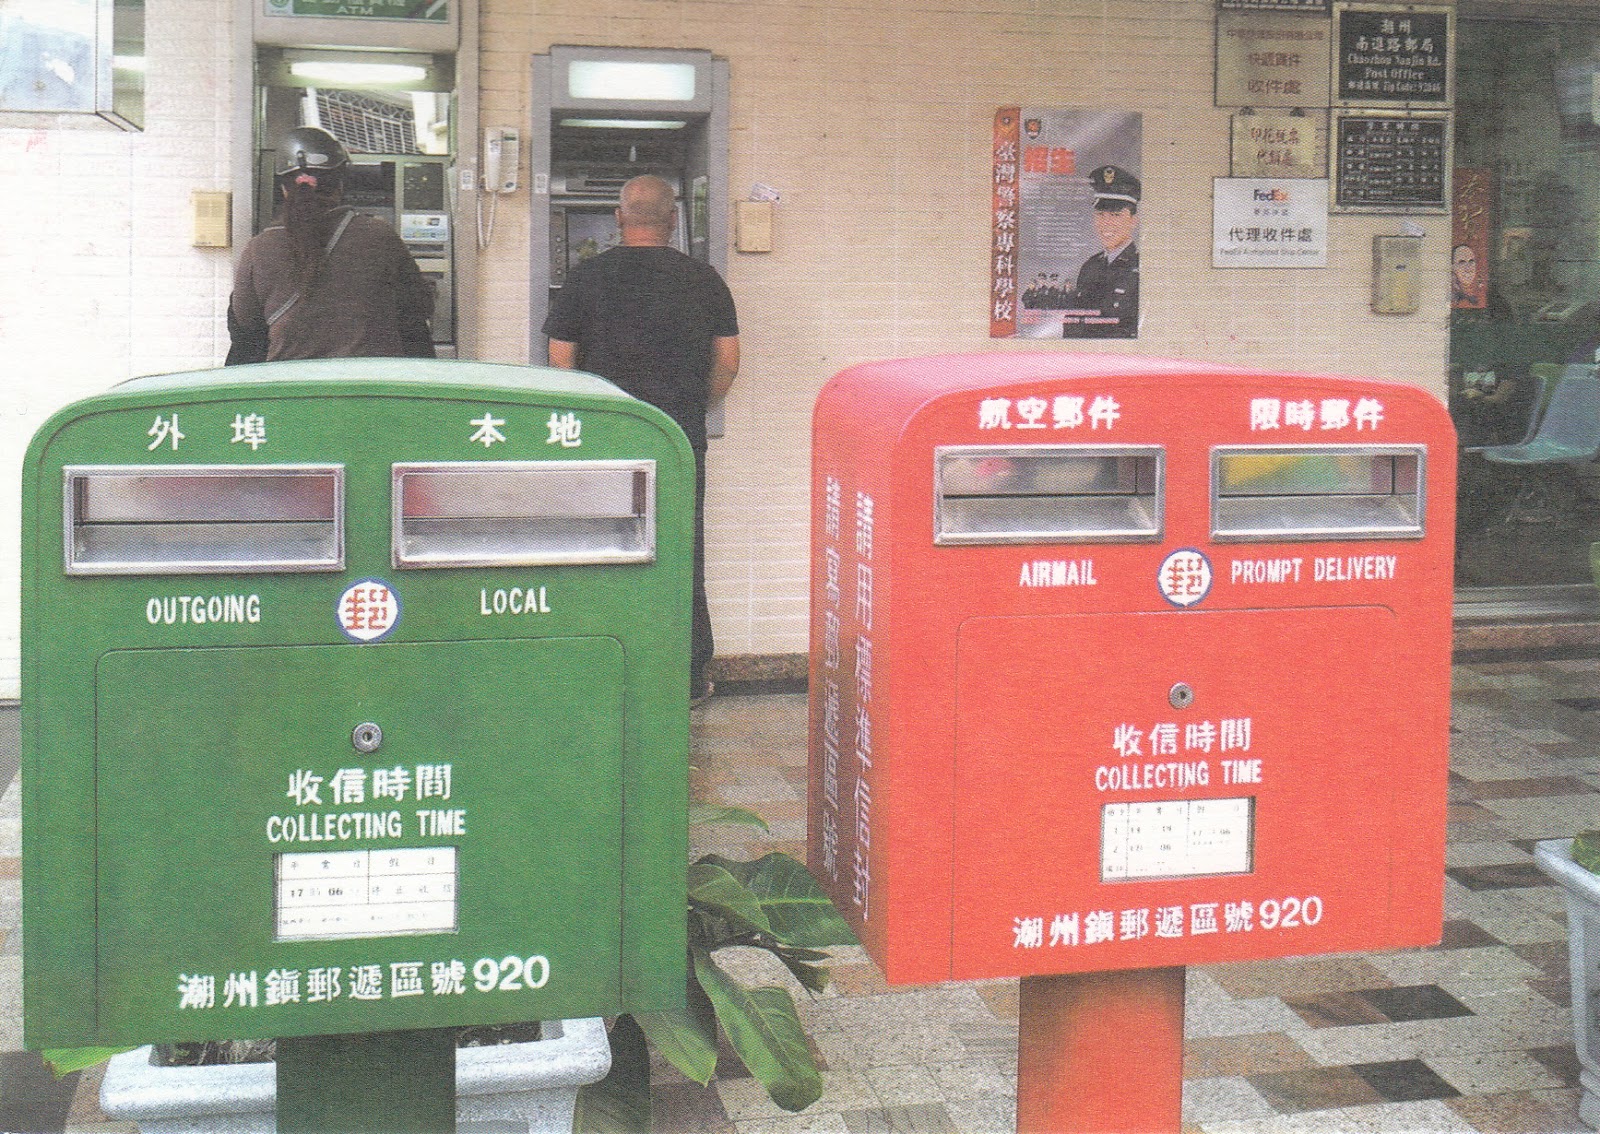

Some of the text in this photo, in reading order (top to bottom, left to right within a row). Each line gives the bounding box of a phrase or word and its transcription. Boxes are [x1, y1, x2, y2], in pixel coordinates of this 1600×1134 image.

[337, 6, 373, 15] ATM
[1365, 68, 1424, 80] Post Office
[1253, 189, 1289, 201] FedEx
[1228, 227, 1313, 243] 代理收件處
[978, 396, 1121, 430] 航空郵件
[1250, 398, 1384, 430] 限時郵件
[147, 412, 267, 451] 外埠
[469, 412, 582, 448] 本地
[1019, 559, 1097, 588] AIRMAIL
[1231, 555, 1397, 584] PROMPT DELIVERY
[146, 594, 262, 625] OUTGOING
[480, 586, 552, 615] LOCAL
[1113, 717, 1251, 757] 收信時間
[287, 764, 452, 806] 收信時間
[1095, 759, 1262, 791] COLLECTING TIME
[266, 809, 467, 843] COLLECTING TIME
